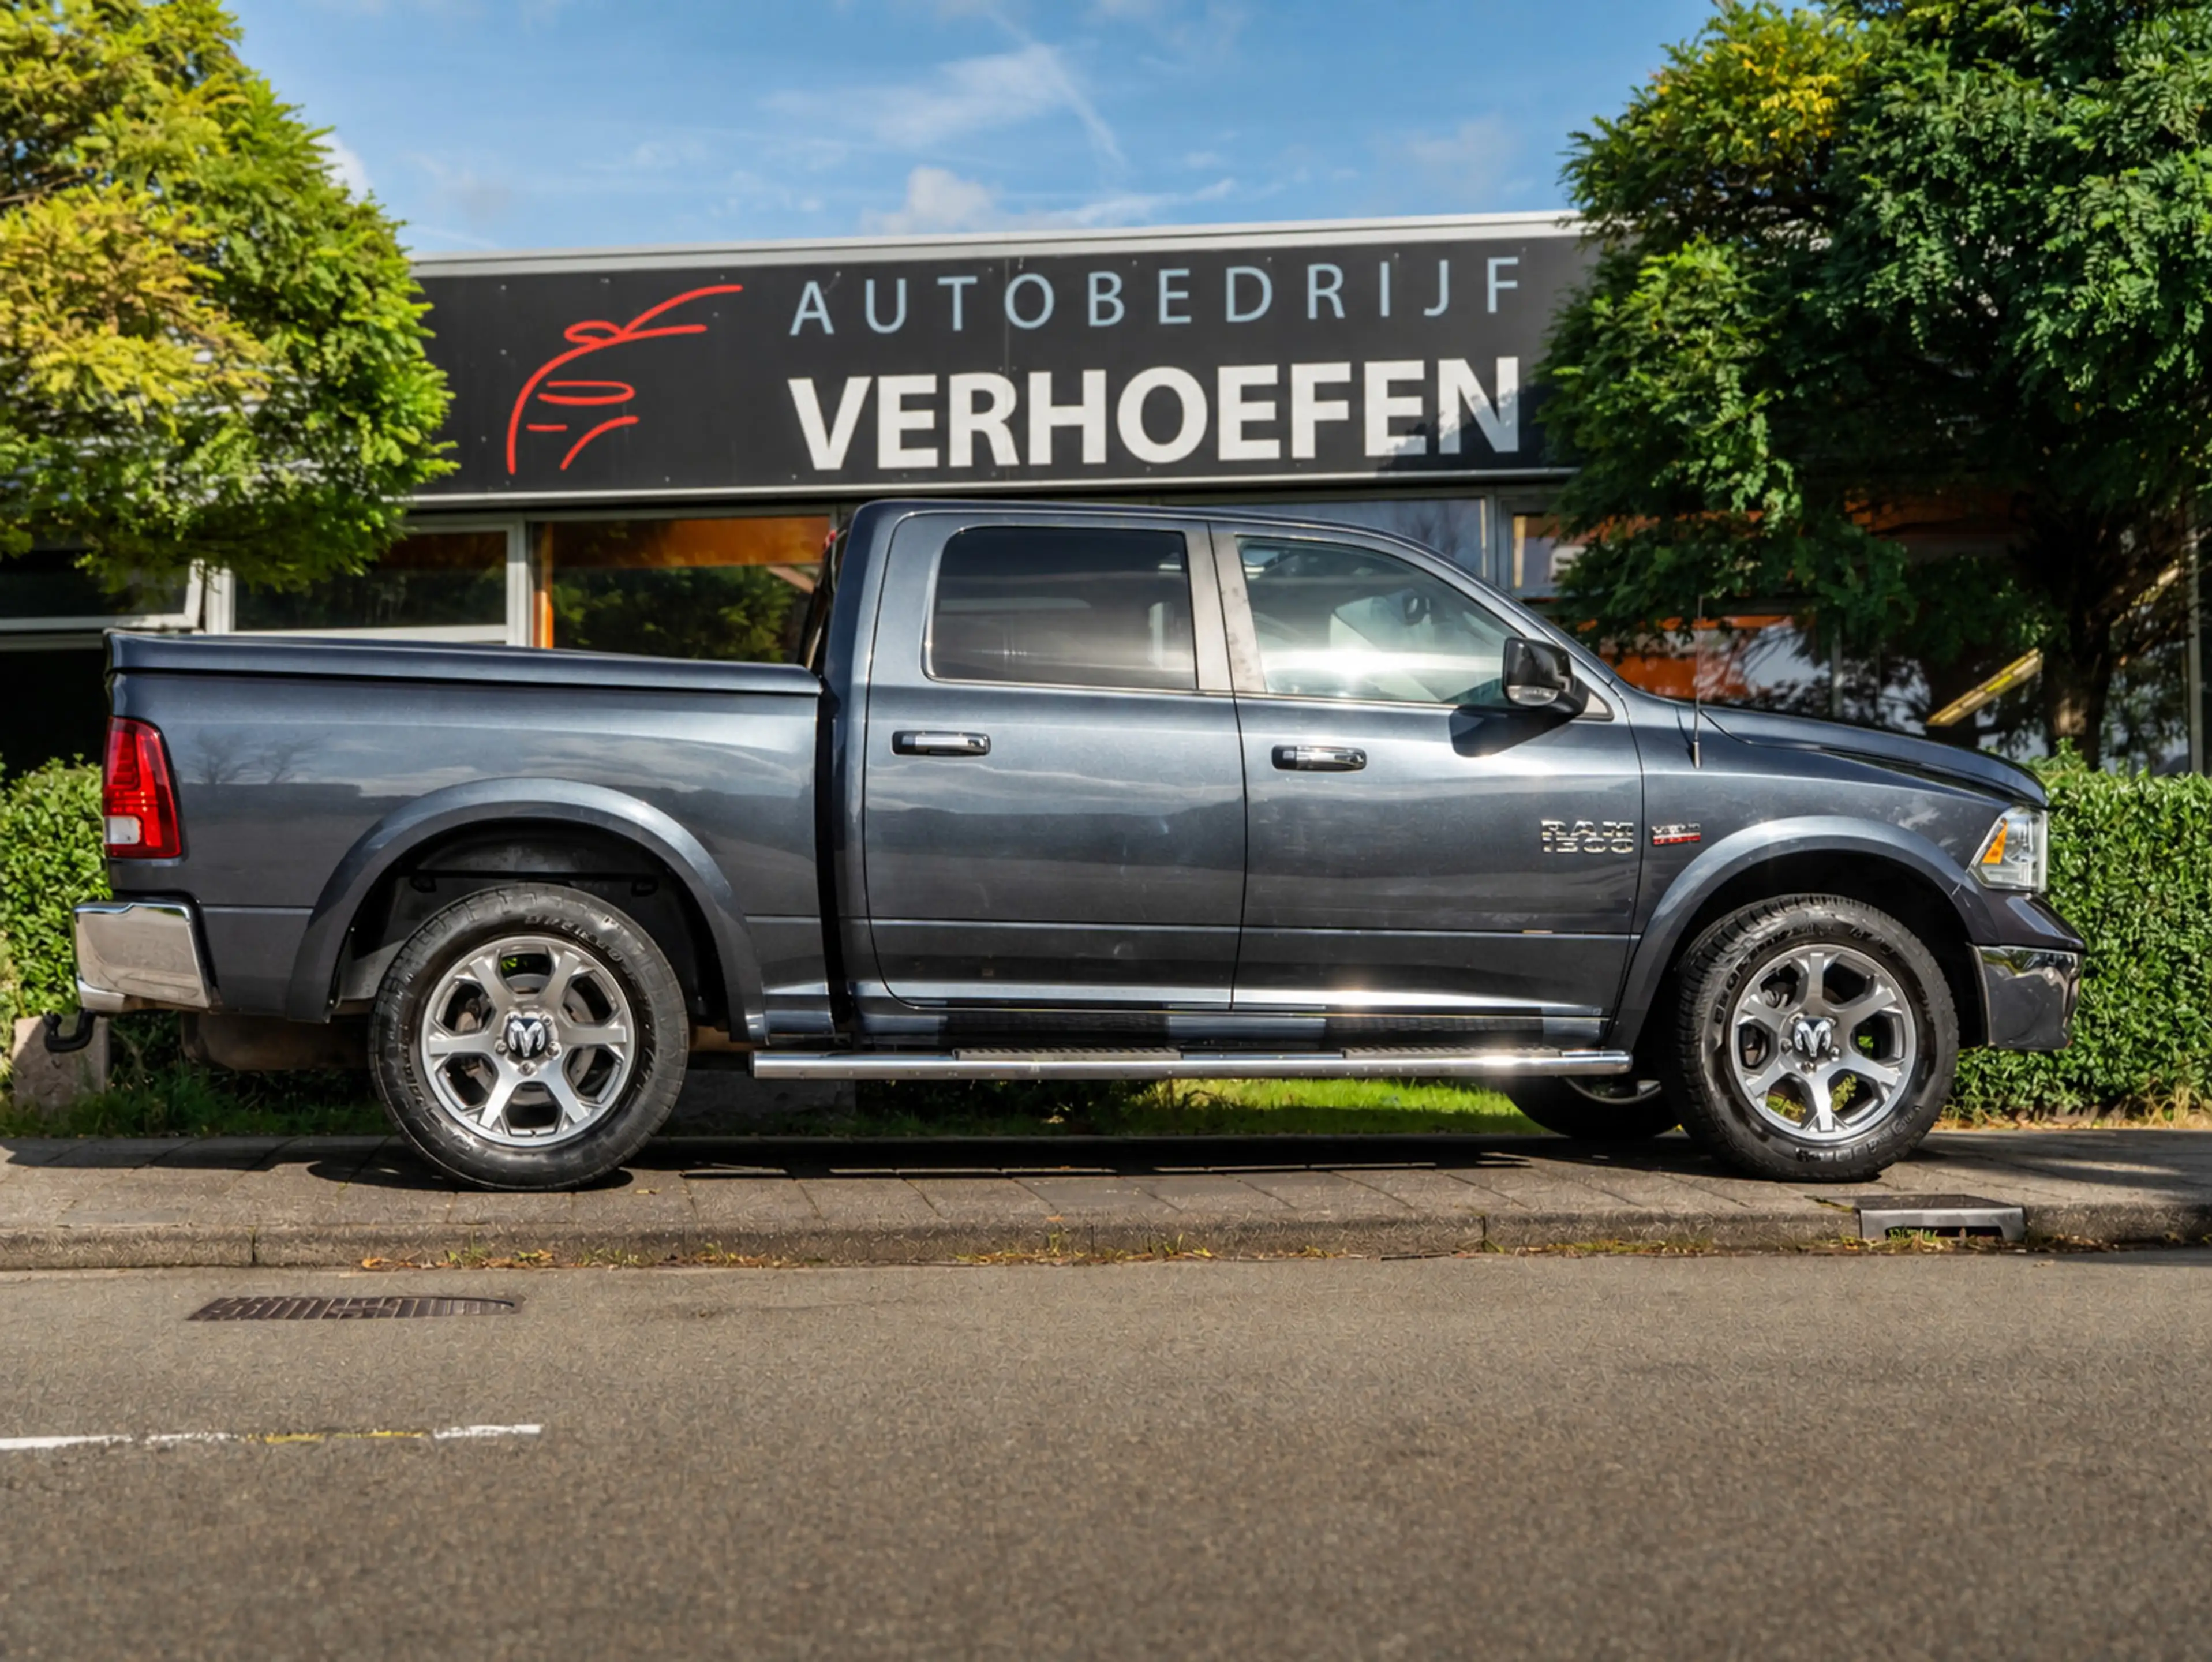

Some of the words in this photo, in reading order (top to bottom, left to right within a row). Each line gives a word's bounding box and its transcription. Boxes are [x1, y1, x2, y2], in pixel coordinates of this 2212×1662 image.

[790, 256, 1519, 336] AUTOBEDRIJF
[788, 355, 1519, 471] VERHOEFEN
[1540, 820, 1634, 837] RAM
[1541, 837, 1635, 854] 1500
